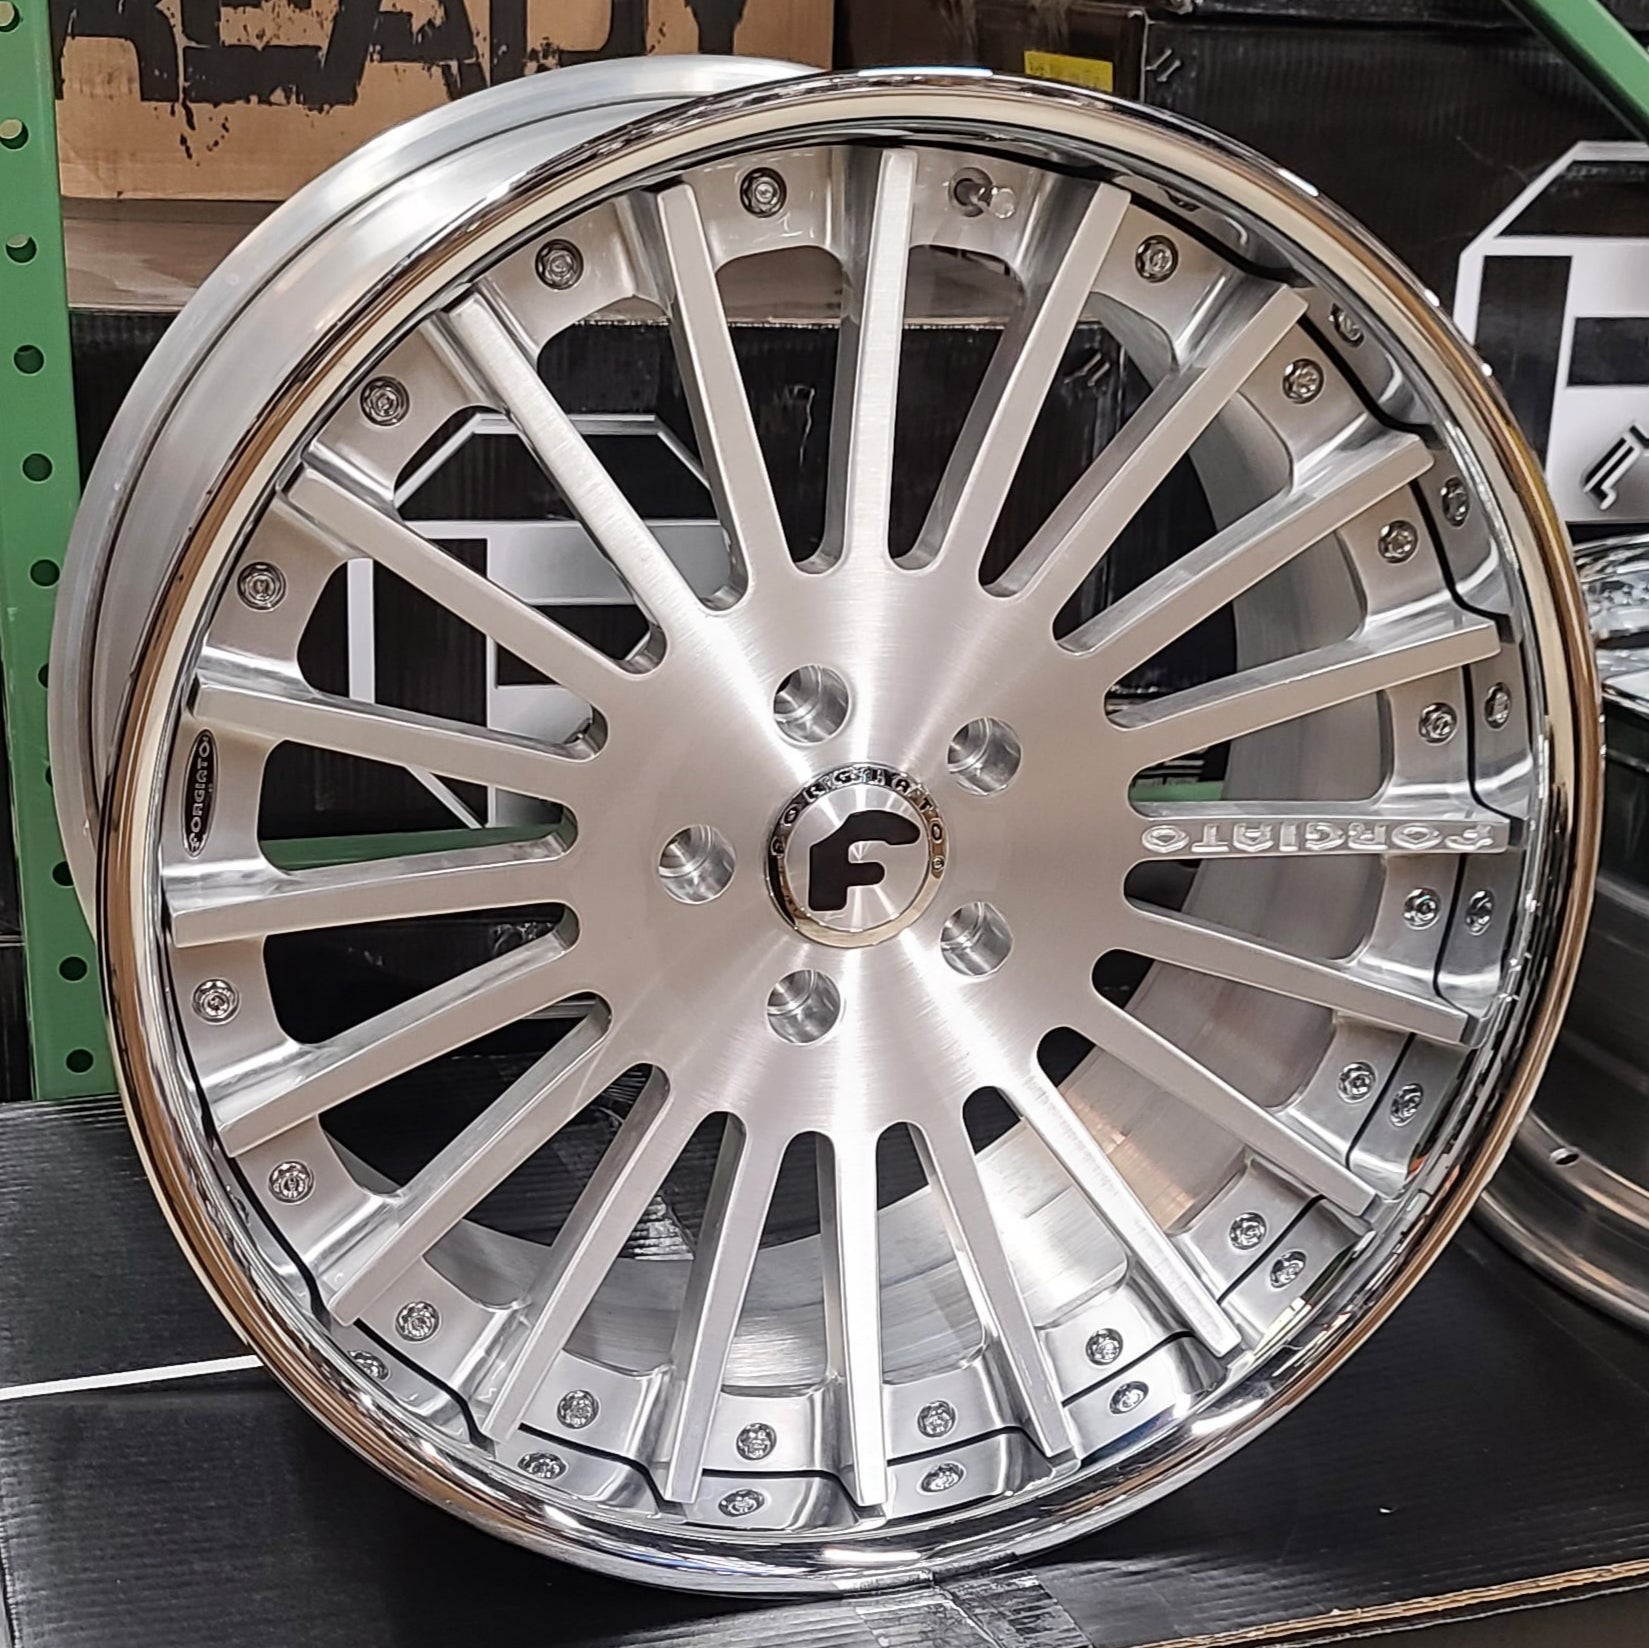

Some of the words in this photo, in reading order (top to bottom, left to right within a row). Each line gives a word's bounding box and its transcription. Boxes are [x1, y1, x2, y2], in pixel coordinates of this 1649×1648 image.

[188, 741, 211, 851] FORGIATO
[1141, 821, 1494, 854] FORGIATO
[808, 809, 921, 912] F
